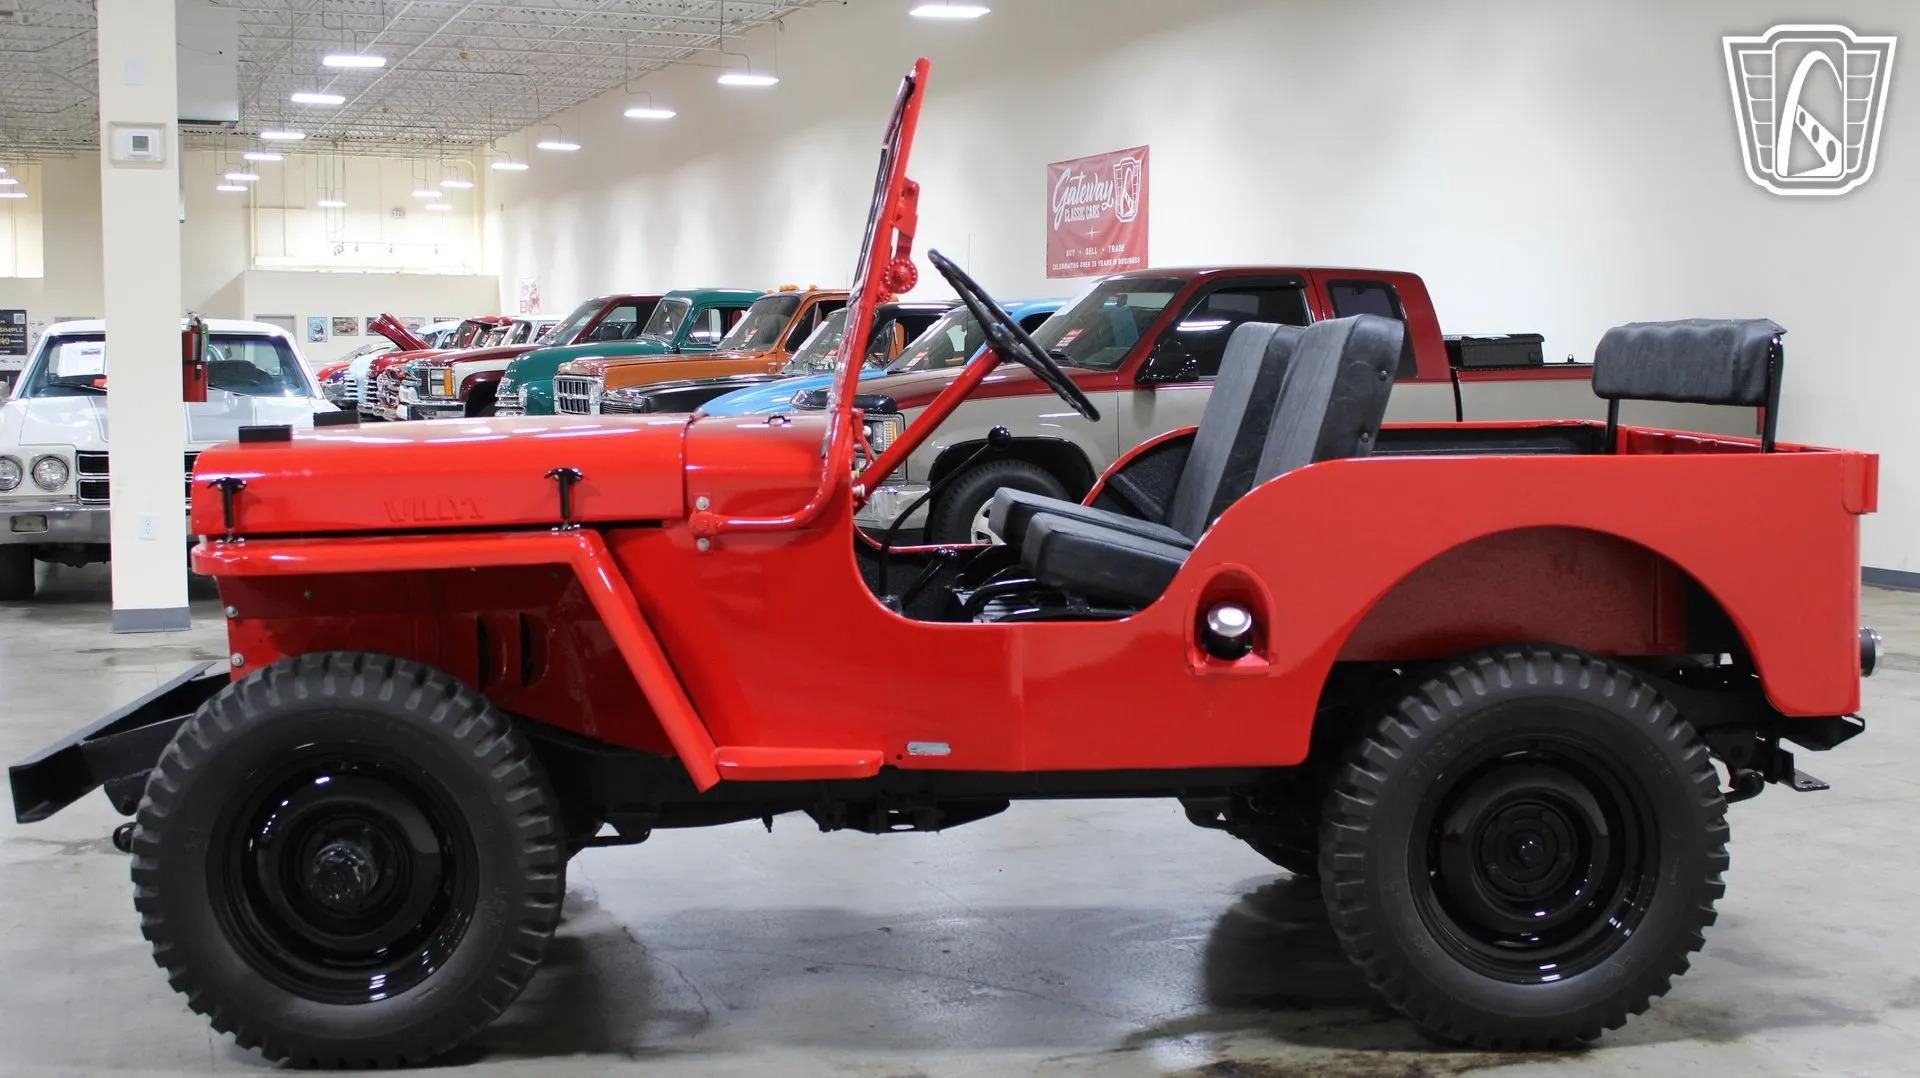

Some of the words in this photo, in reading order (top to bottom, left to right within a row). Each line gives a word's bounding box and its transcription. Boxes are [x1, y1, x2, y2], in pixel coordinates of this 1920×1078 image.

[1052, 167, 1114, 231] Gateway
[1064, 206, 1085, 222] CLASSIC
[1085, 204, 1100, 220] CARS
[1085, 246, 1097, 256] SELL
[1108, 243, 1125, 253] TRADE
